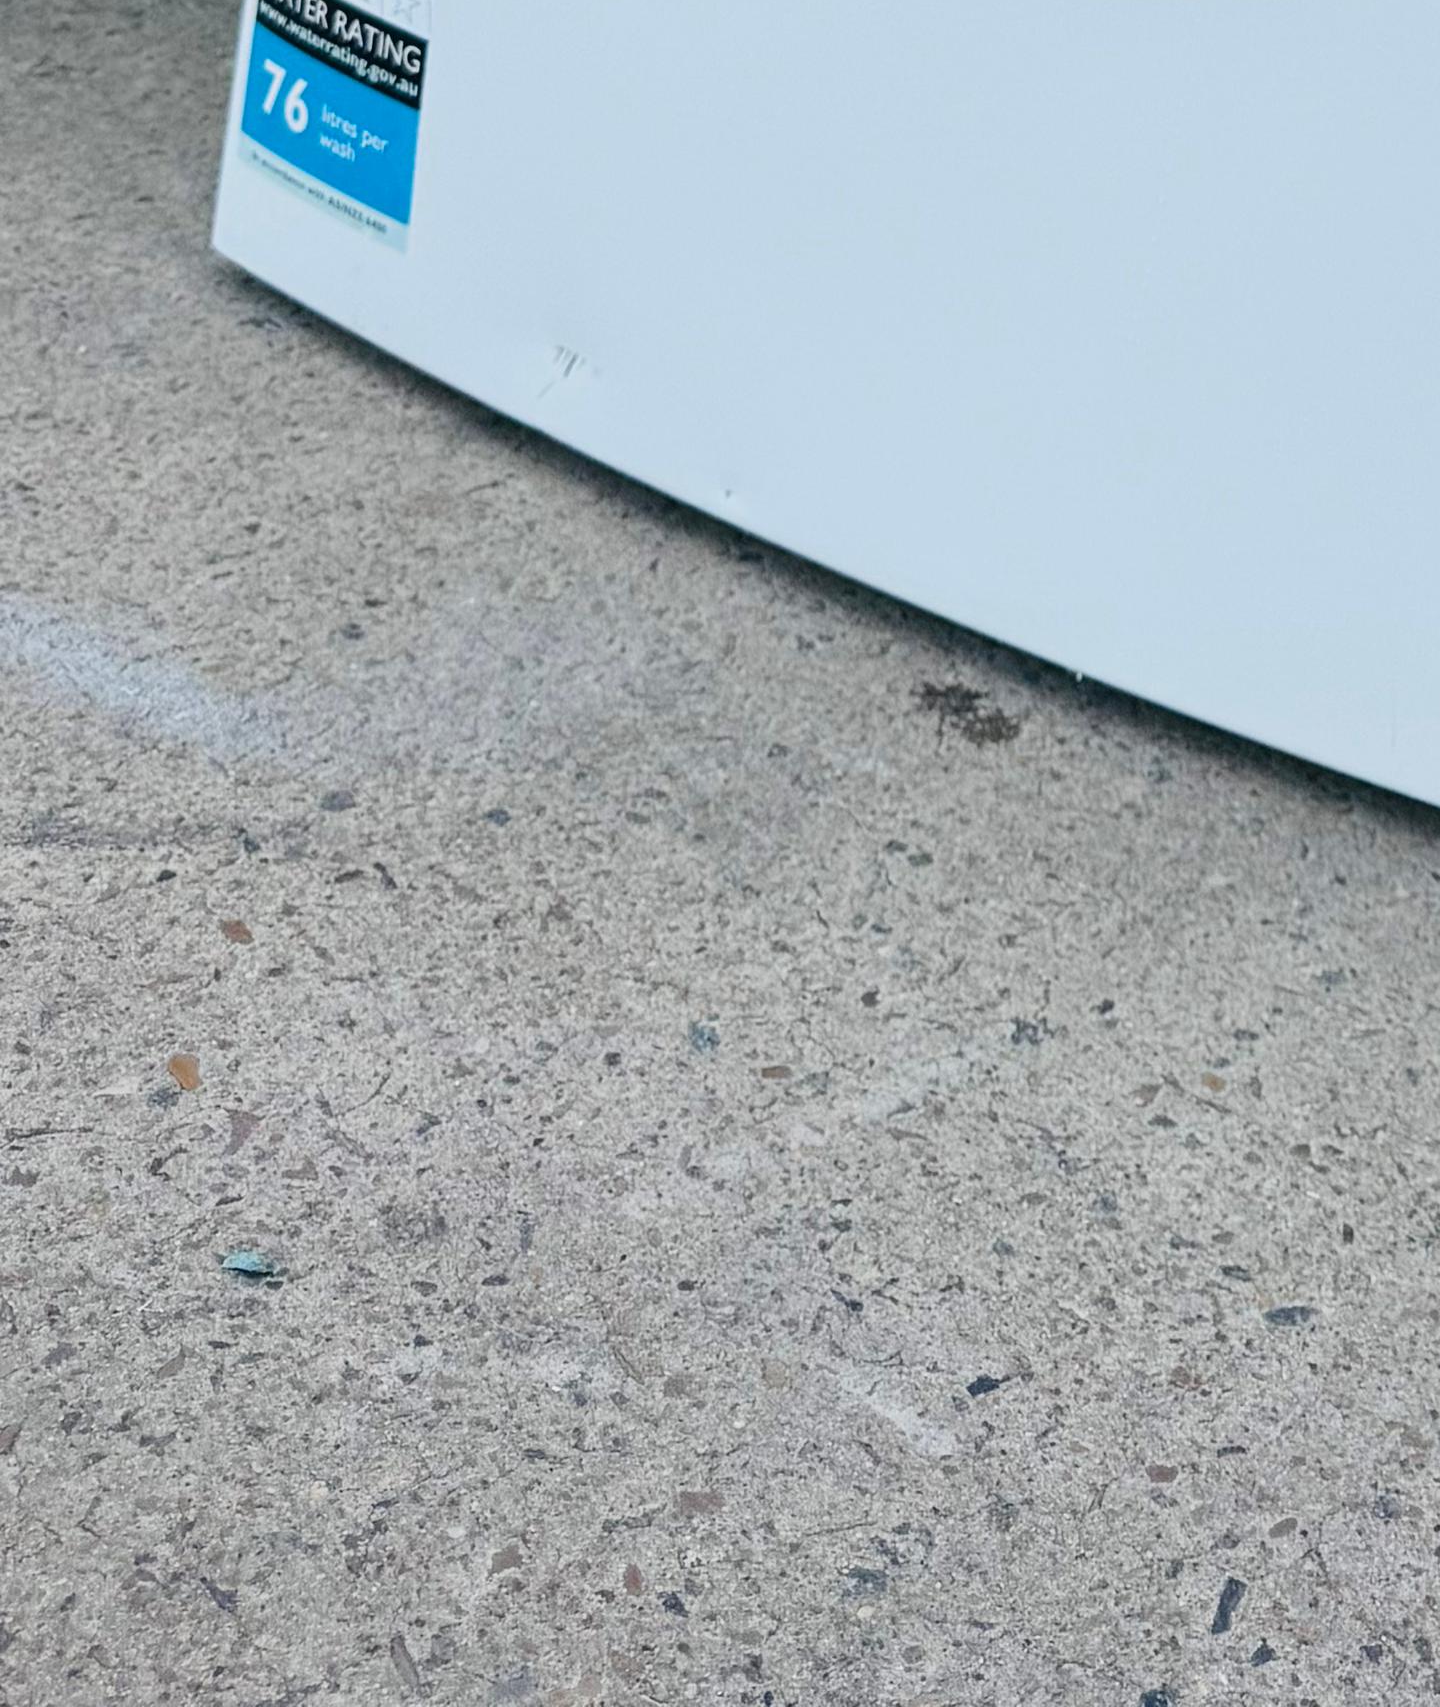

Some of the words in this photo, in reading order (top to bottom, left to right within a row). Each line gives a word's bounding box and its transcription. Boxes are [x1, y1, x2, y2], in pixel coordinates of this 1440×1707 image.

[259, 0, 419, 97] www.waterrating.gov.au
[333, 10, 422, 75] RATING
[262, 57, 309, 134] 76
[319, 133, 356, 163] wash
[321, 103, 358, 139] litres
[360, 130, 390, 154] per
